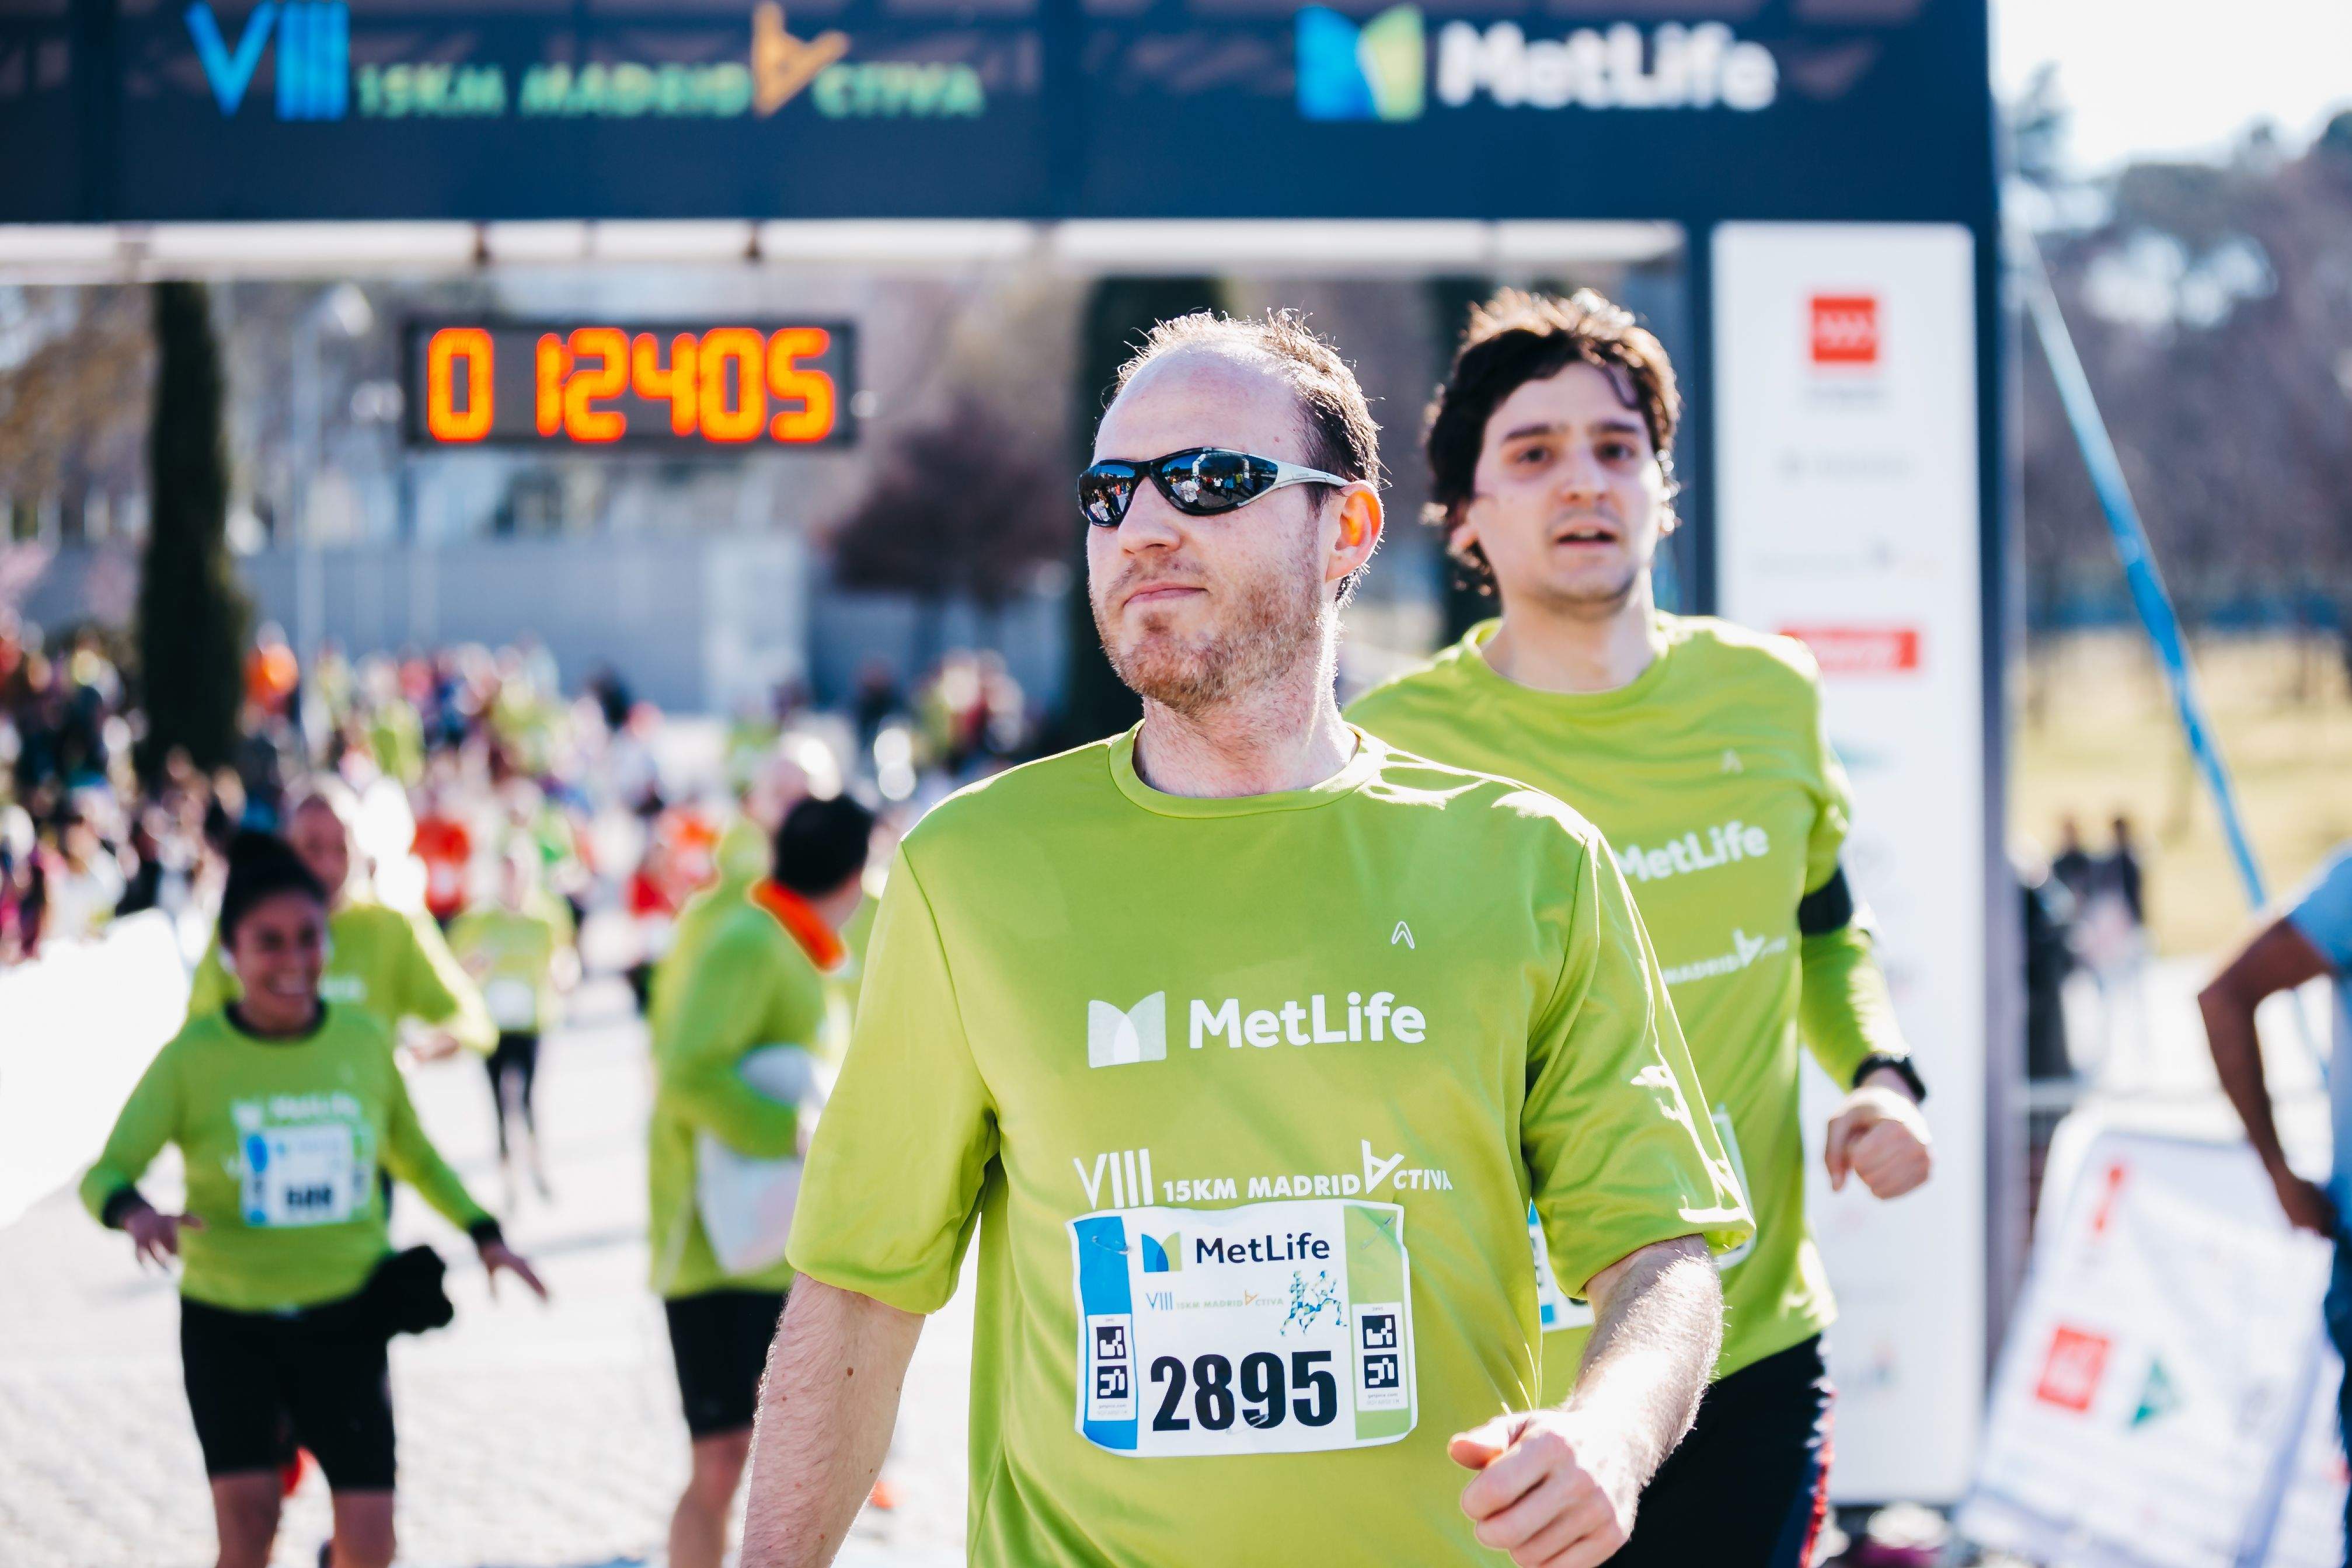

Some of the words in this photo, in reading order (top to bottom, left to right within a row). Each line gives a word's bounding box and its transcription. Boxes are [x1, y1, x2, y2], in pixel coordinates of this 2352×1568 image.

[1437, 21, 1778, 110] MetLife
[427, 327, 493, 442] 0
[1189, 991, 1426, 1048] MetLife
[1073, 1148, 1154, 1210] VIII
[1162, 1177, 1238, 1203] 15KM
[1248, 1173, 1361, 1198] MADRID
[1196, 1232, 1330, 1264] MetLife
[1145, 1291, 1173, 1310] VIII
[1204, 1299, 1244, 1308] MADRID
[1150, 1350, 1337, 1432] 2895
